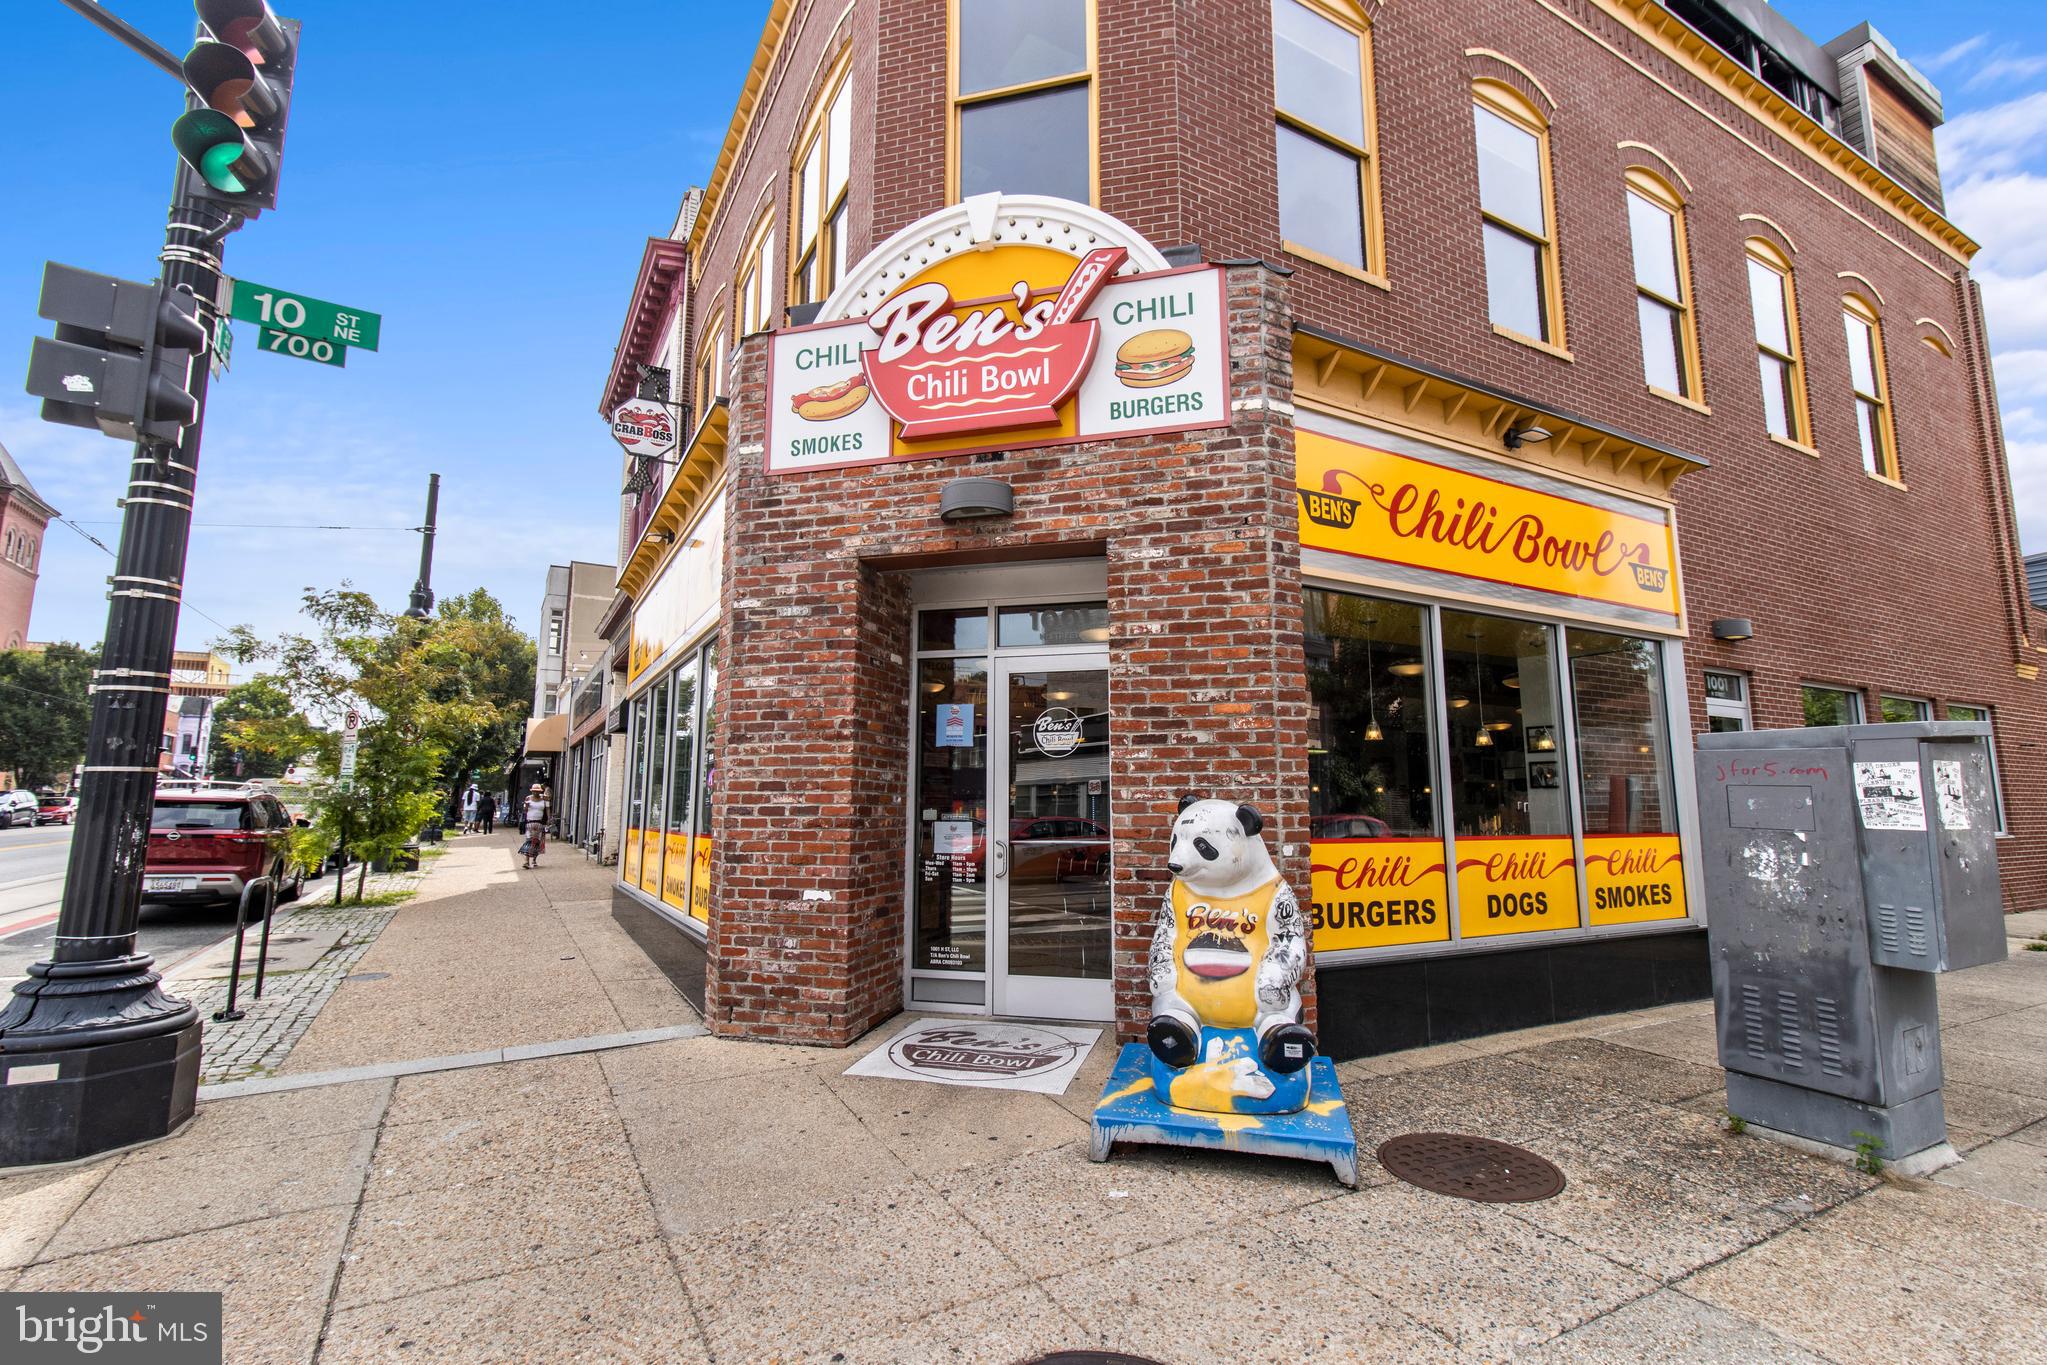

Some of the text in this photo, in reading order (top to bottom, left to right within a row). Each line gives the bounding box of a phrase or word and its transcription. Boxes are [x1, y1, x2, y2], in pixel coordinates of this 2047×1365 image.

[253, 292, 307, 329] 10
[335, 312, 361, 329] ST
[867, 281, 1057, 364] Ben's
[1112, 291, 1195, 326] CHILI
[269, 330, 334, 362] 700
[333, 325, 361, 343] NE
[795, 341, 863, 371] CHILI
[906, 358, 1050, 401] Chili Bowl
[1109, 391, 1204, 421] BURGERS
[790, 432, 863, 457] SMOKES
[1309, 495, 1353, 526] BEN'S
[1389, 483, 1628, 577] Chili Bowl
[1635, 566, 1665, 590] BEN'S
[1706, 675, 1728, 692] 1001
[1037, 716, 1072, 731] Ben's
[1335, 855, 1416, 890] Chili
[1485, 851, 1554, 883] Chili
[1606, 847, 1664, 877] Chili
[1487, 891, 1549, 919] DOGS
[1594, 883, 1673, 911] SMOKES
[1186, 902, 1259, 935] Ben's
[1311, 898, 1438, 931] BURGERS
[918, 1030, 1042, 1051] Ben's
[912, 1049, 1036, 1069] Chili Bowl
